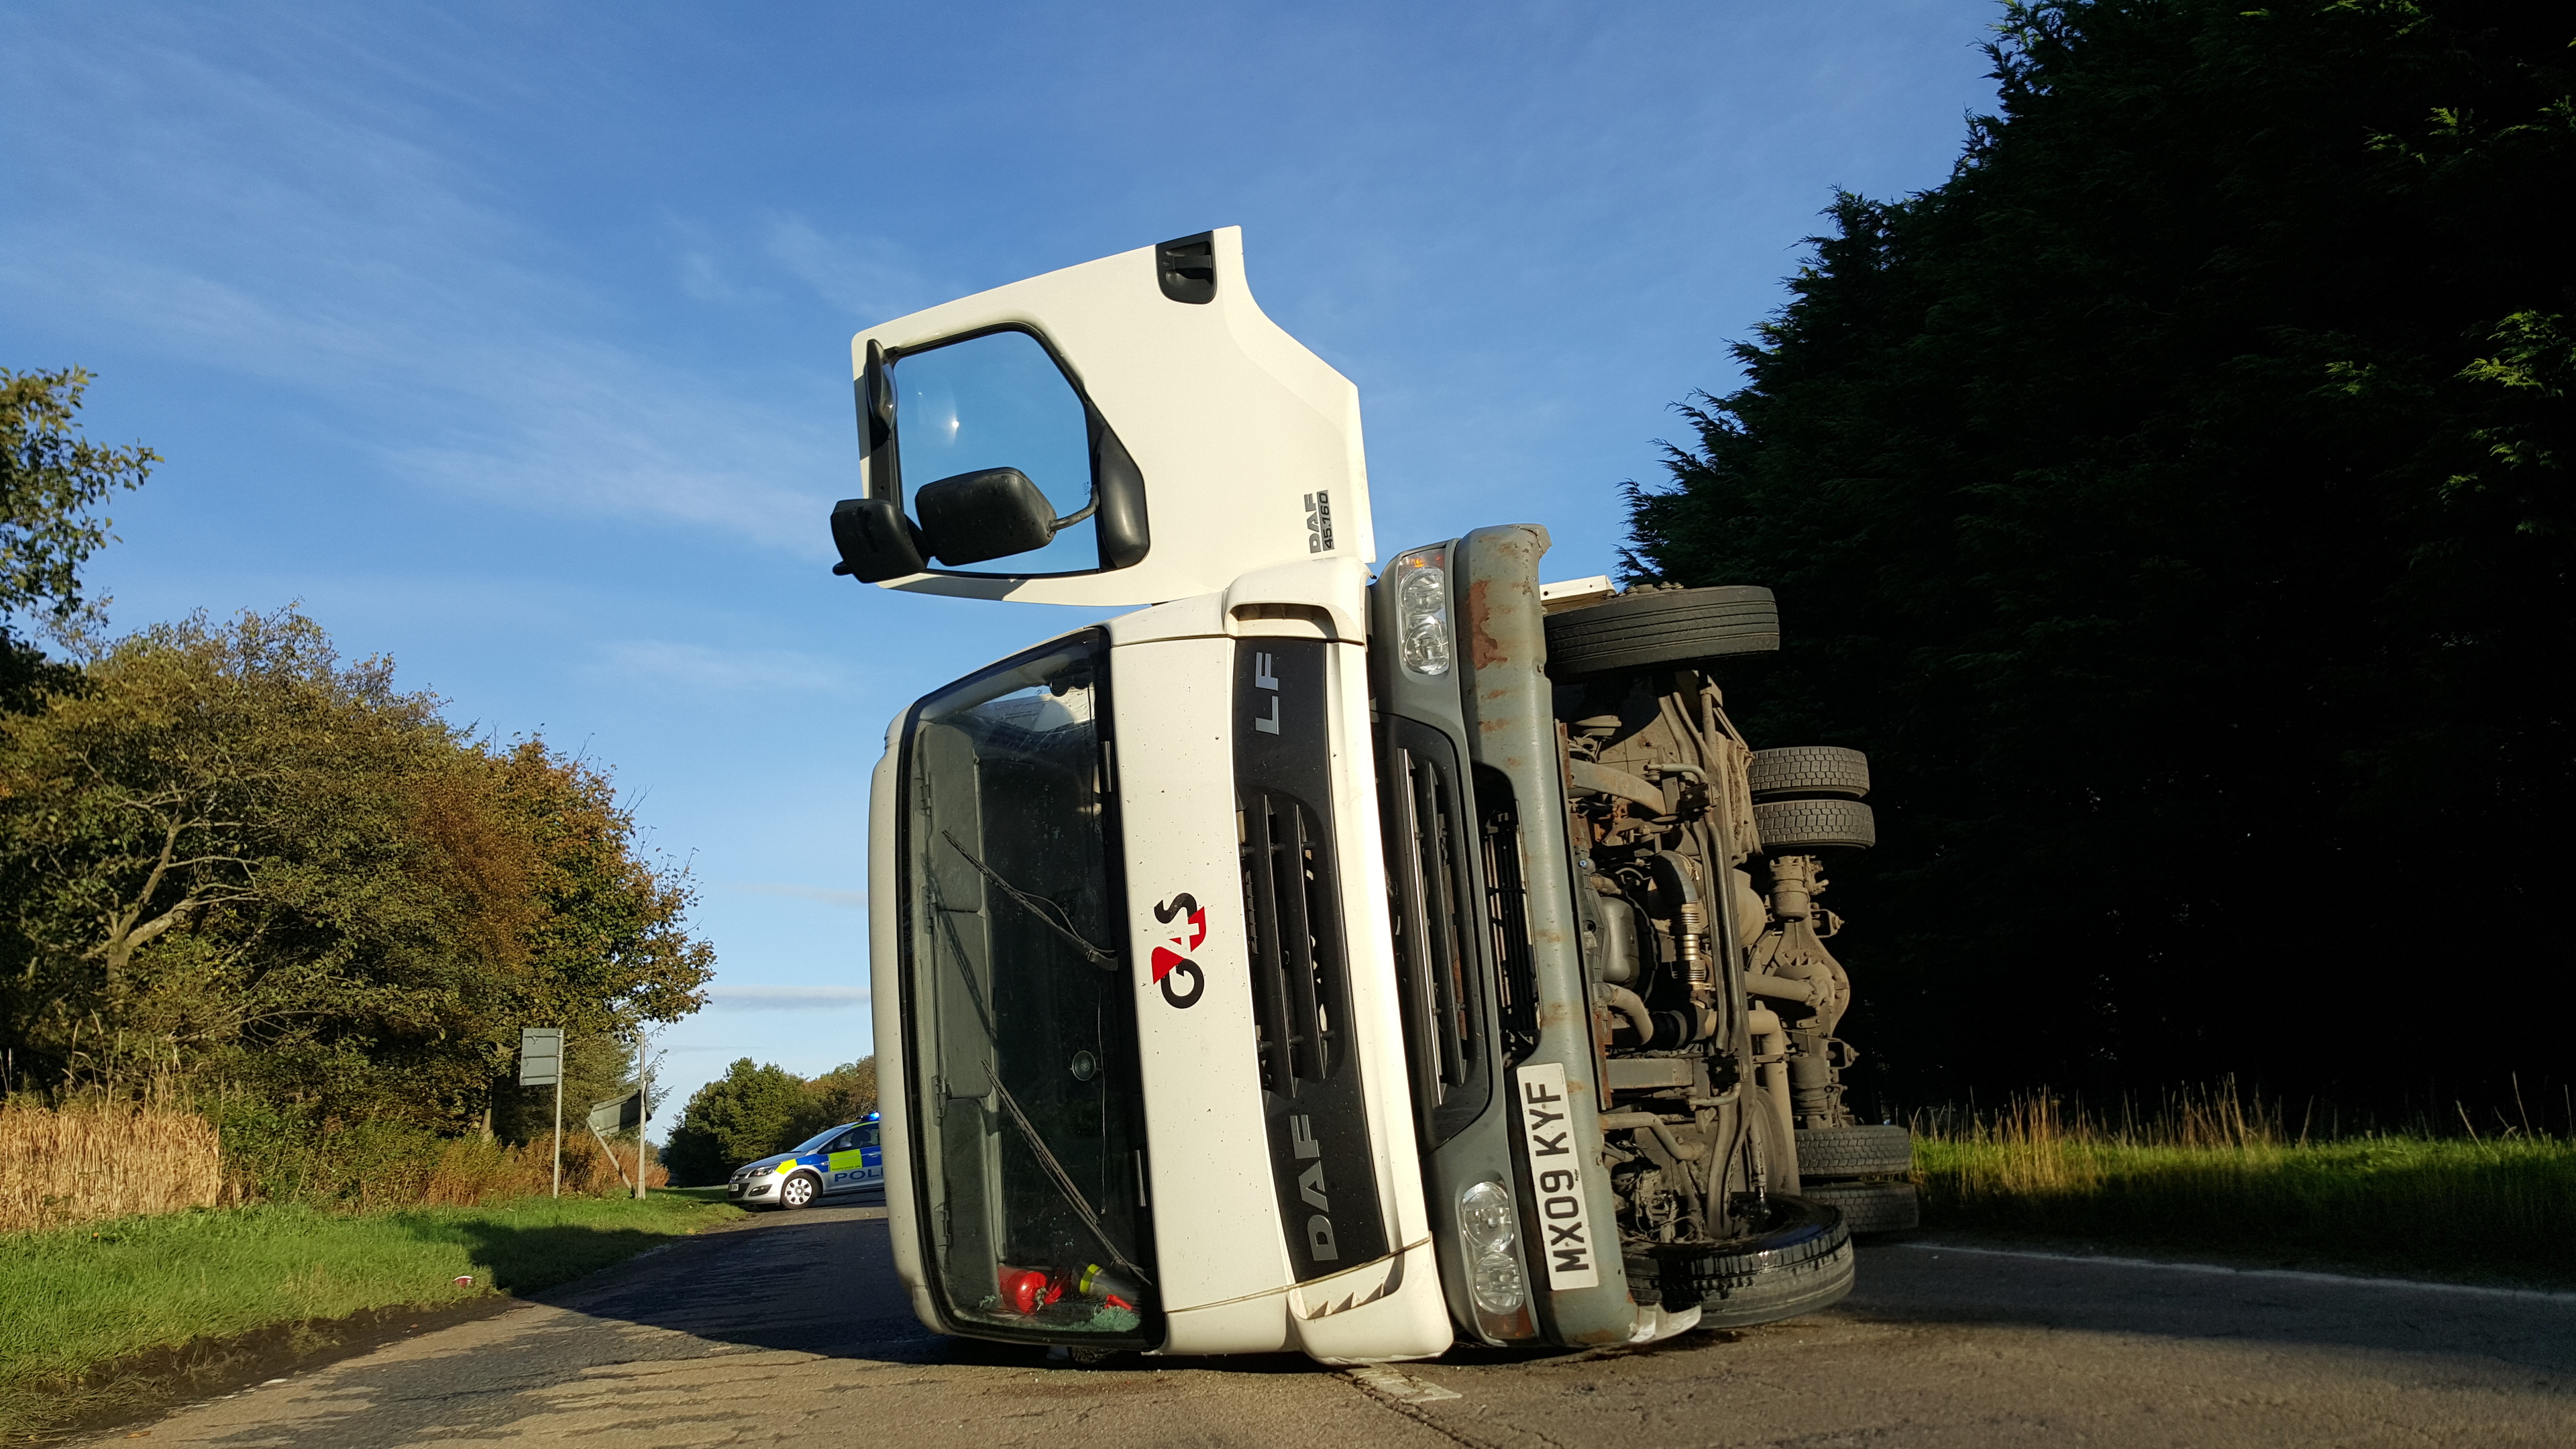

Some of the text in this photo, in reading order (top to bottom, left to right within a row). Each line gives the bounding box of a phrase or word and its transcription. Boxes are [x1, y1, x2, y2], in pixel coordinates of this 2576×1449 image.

[1304, 493, 1322, 553] DAF
[1319, 492, 1334, 549] 45.160
[1255, 652, 1279, 735] LF
[1151, 892, 1206, 1009] G4S
[1289, 1115, 1338, 1261] DAF
[1525, 1082, 1589, 1273] MX09 KYF
